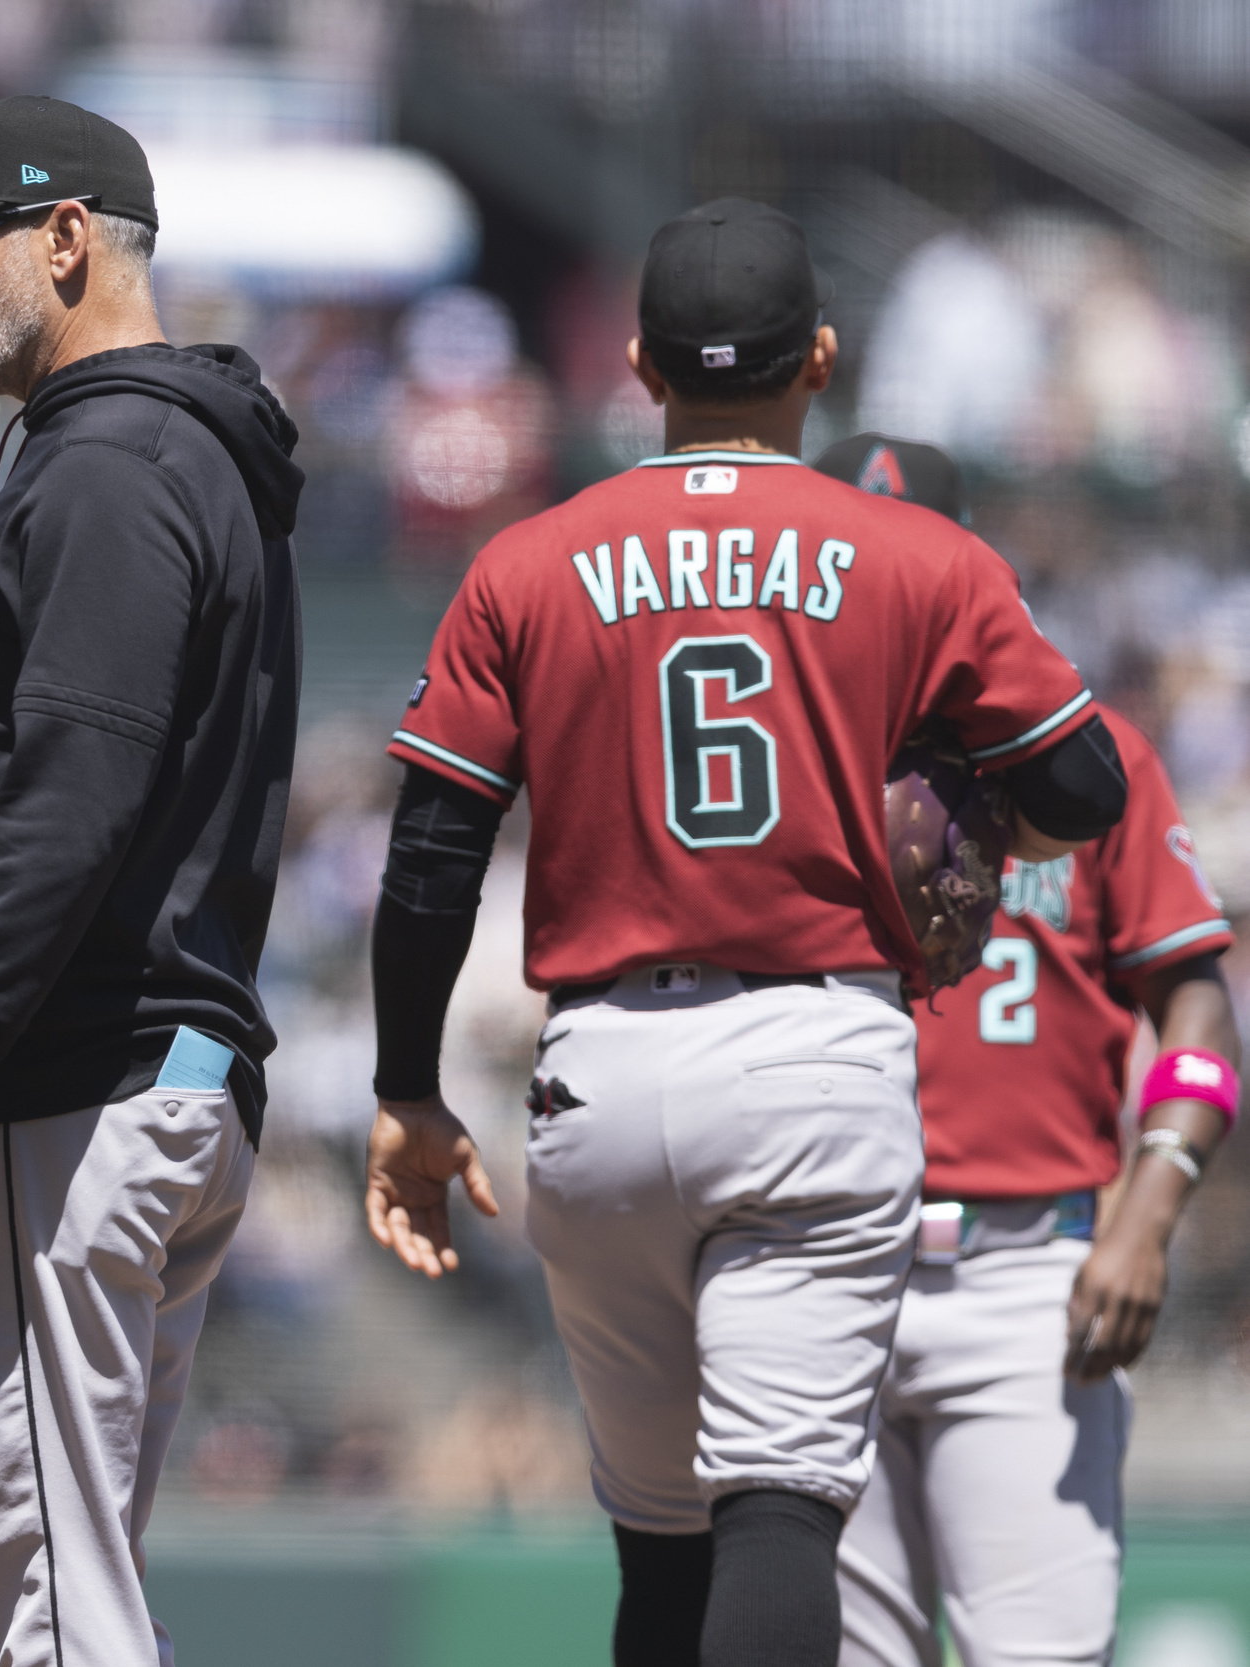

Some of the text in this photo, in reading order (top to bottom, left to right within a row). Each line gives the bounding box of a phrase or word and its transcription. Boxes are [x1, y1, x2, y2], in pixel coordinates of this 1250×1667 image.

[571, 528, 855, 624] VARGAS
[659, 634, 780, 850] 6
[979, 936, 1040, 1046] 2
